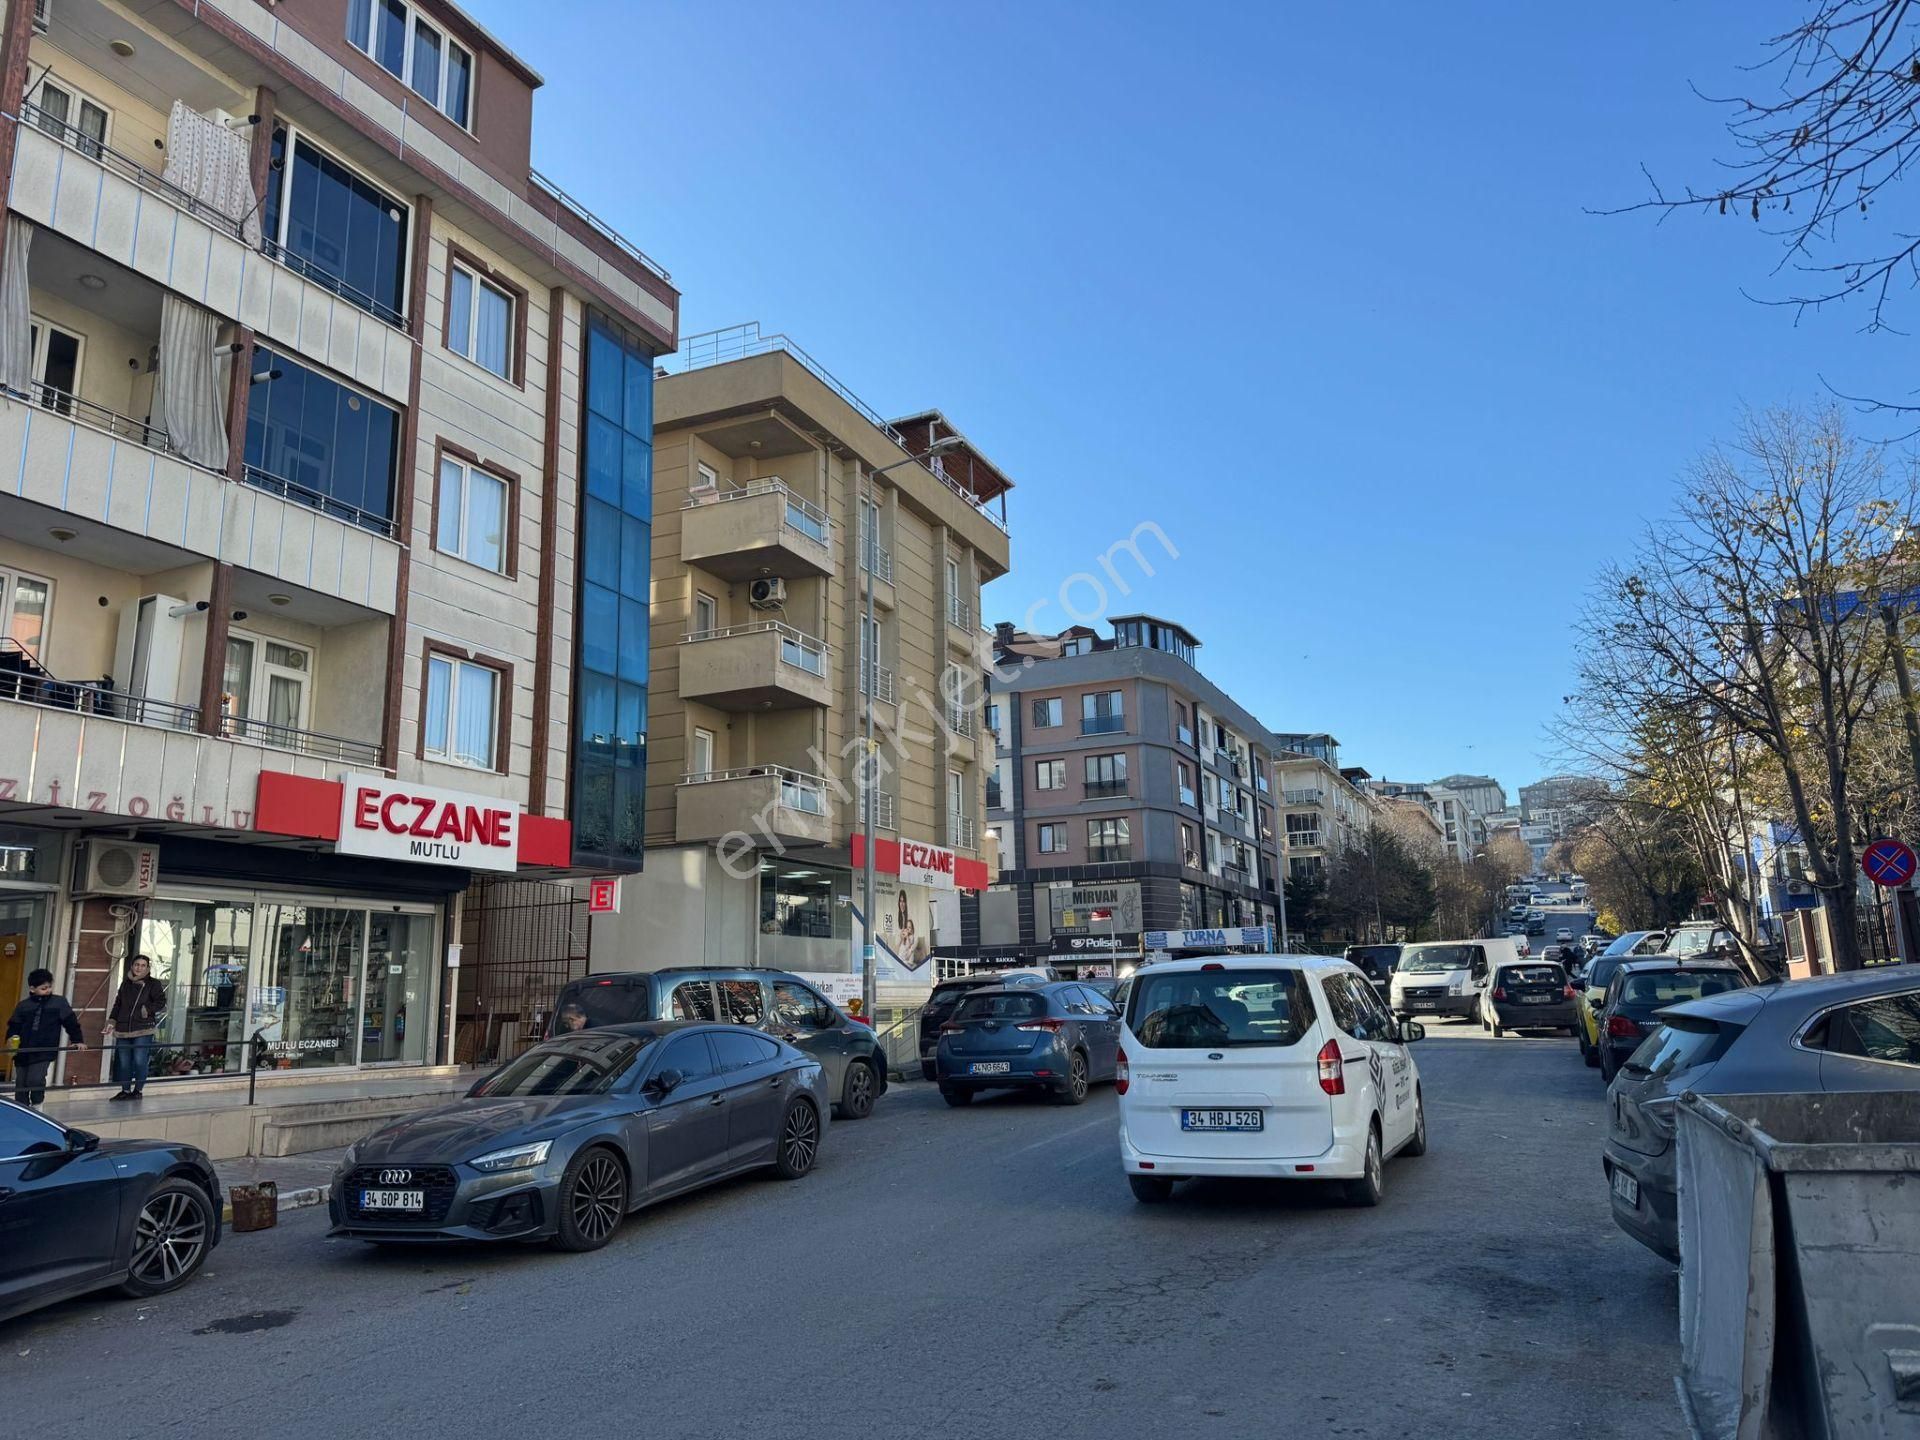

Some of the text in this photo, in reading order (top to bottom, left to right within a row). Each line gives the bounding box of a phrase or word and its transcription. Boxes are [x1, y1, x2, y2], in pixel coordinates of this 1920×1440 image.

[355, 787, 511, 847] ECZANE
[410, 841, 460, 860] MUTLU
[903, 842, 953, 875] ECZANE
[139, 851, 151, 889] VESTEL
[923, 872, 934, 884] SİTE
[596, 886, 608, 906] E
[1073, 888, 1118, 905] MİRVAN
[885, 914, 893, 924] 50
[1086, 938, 1122, 948] Polisan
[1182, 929, 1226, 942] TURNA
[267, 1037, 339, 1050] MUTLU ECZANESİ
[1190, 1112, 1204, 1125] 34
[1209, 1112, 1231, 1125] HBJ
[1236, 1111, 1258, 1125] 526
[366, 1192, 421, 1207] 34 GOP 814
